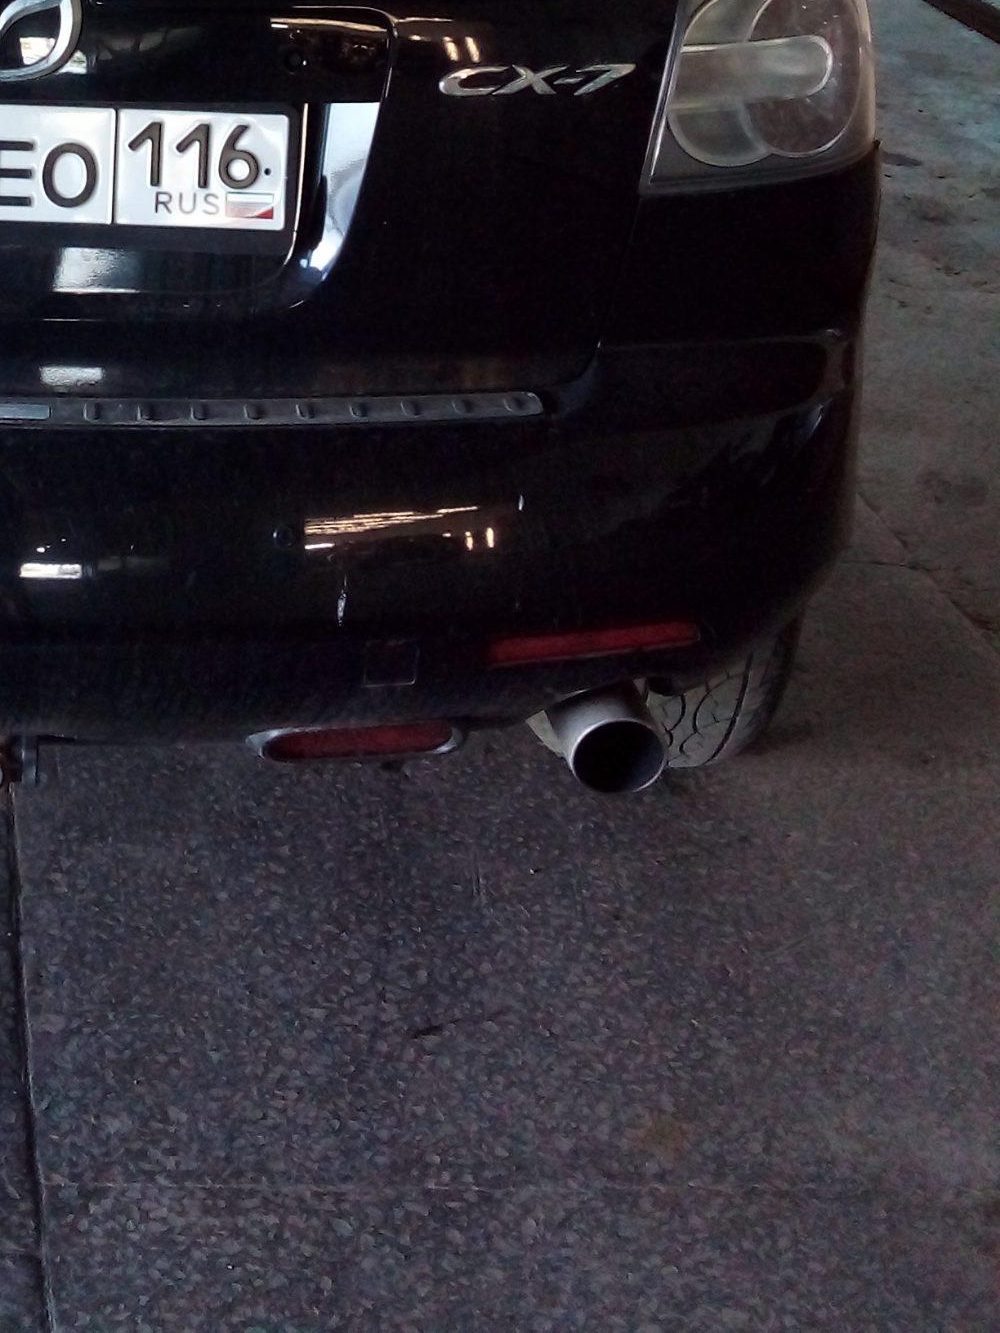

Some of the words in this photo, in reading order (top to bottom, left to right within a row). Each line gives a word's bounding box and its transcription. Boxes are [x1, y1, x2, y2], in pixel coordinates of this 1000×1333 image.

[439, 64, 636, 96] CX-7
[127, 122, 260, 189] 116
[154, 191, 221, 216] RUS
